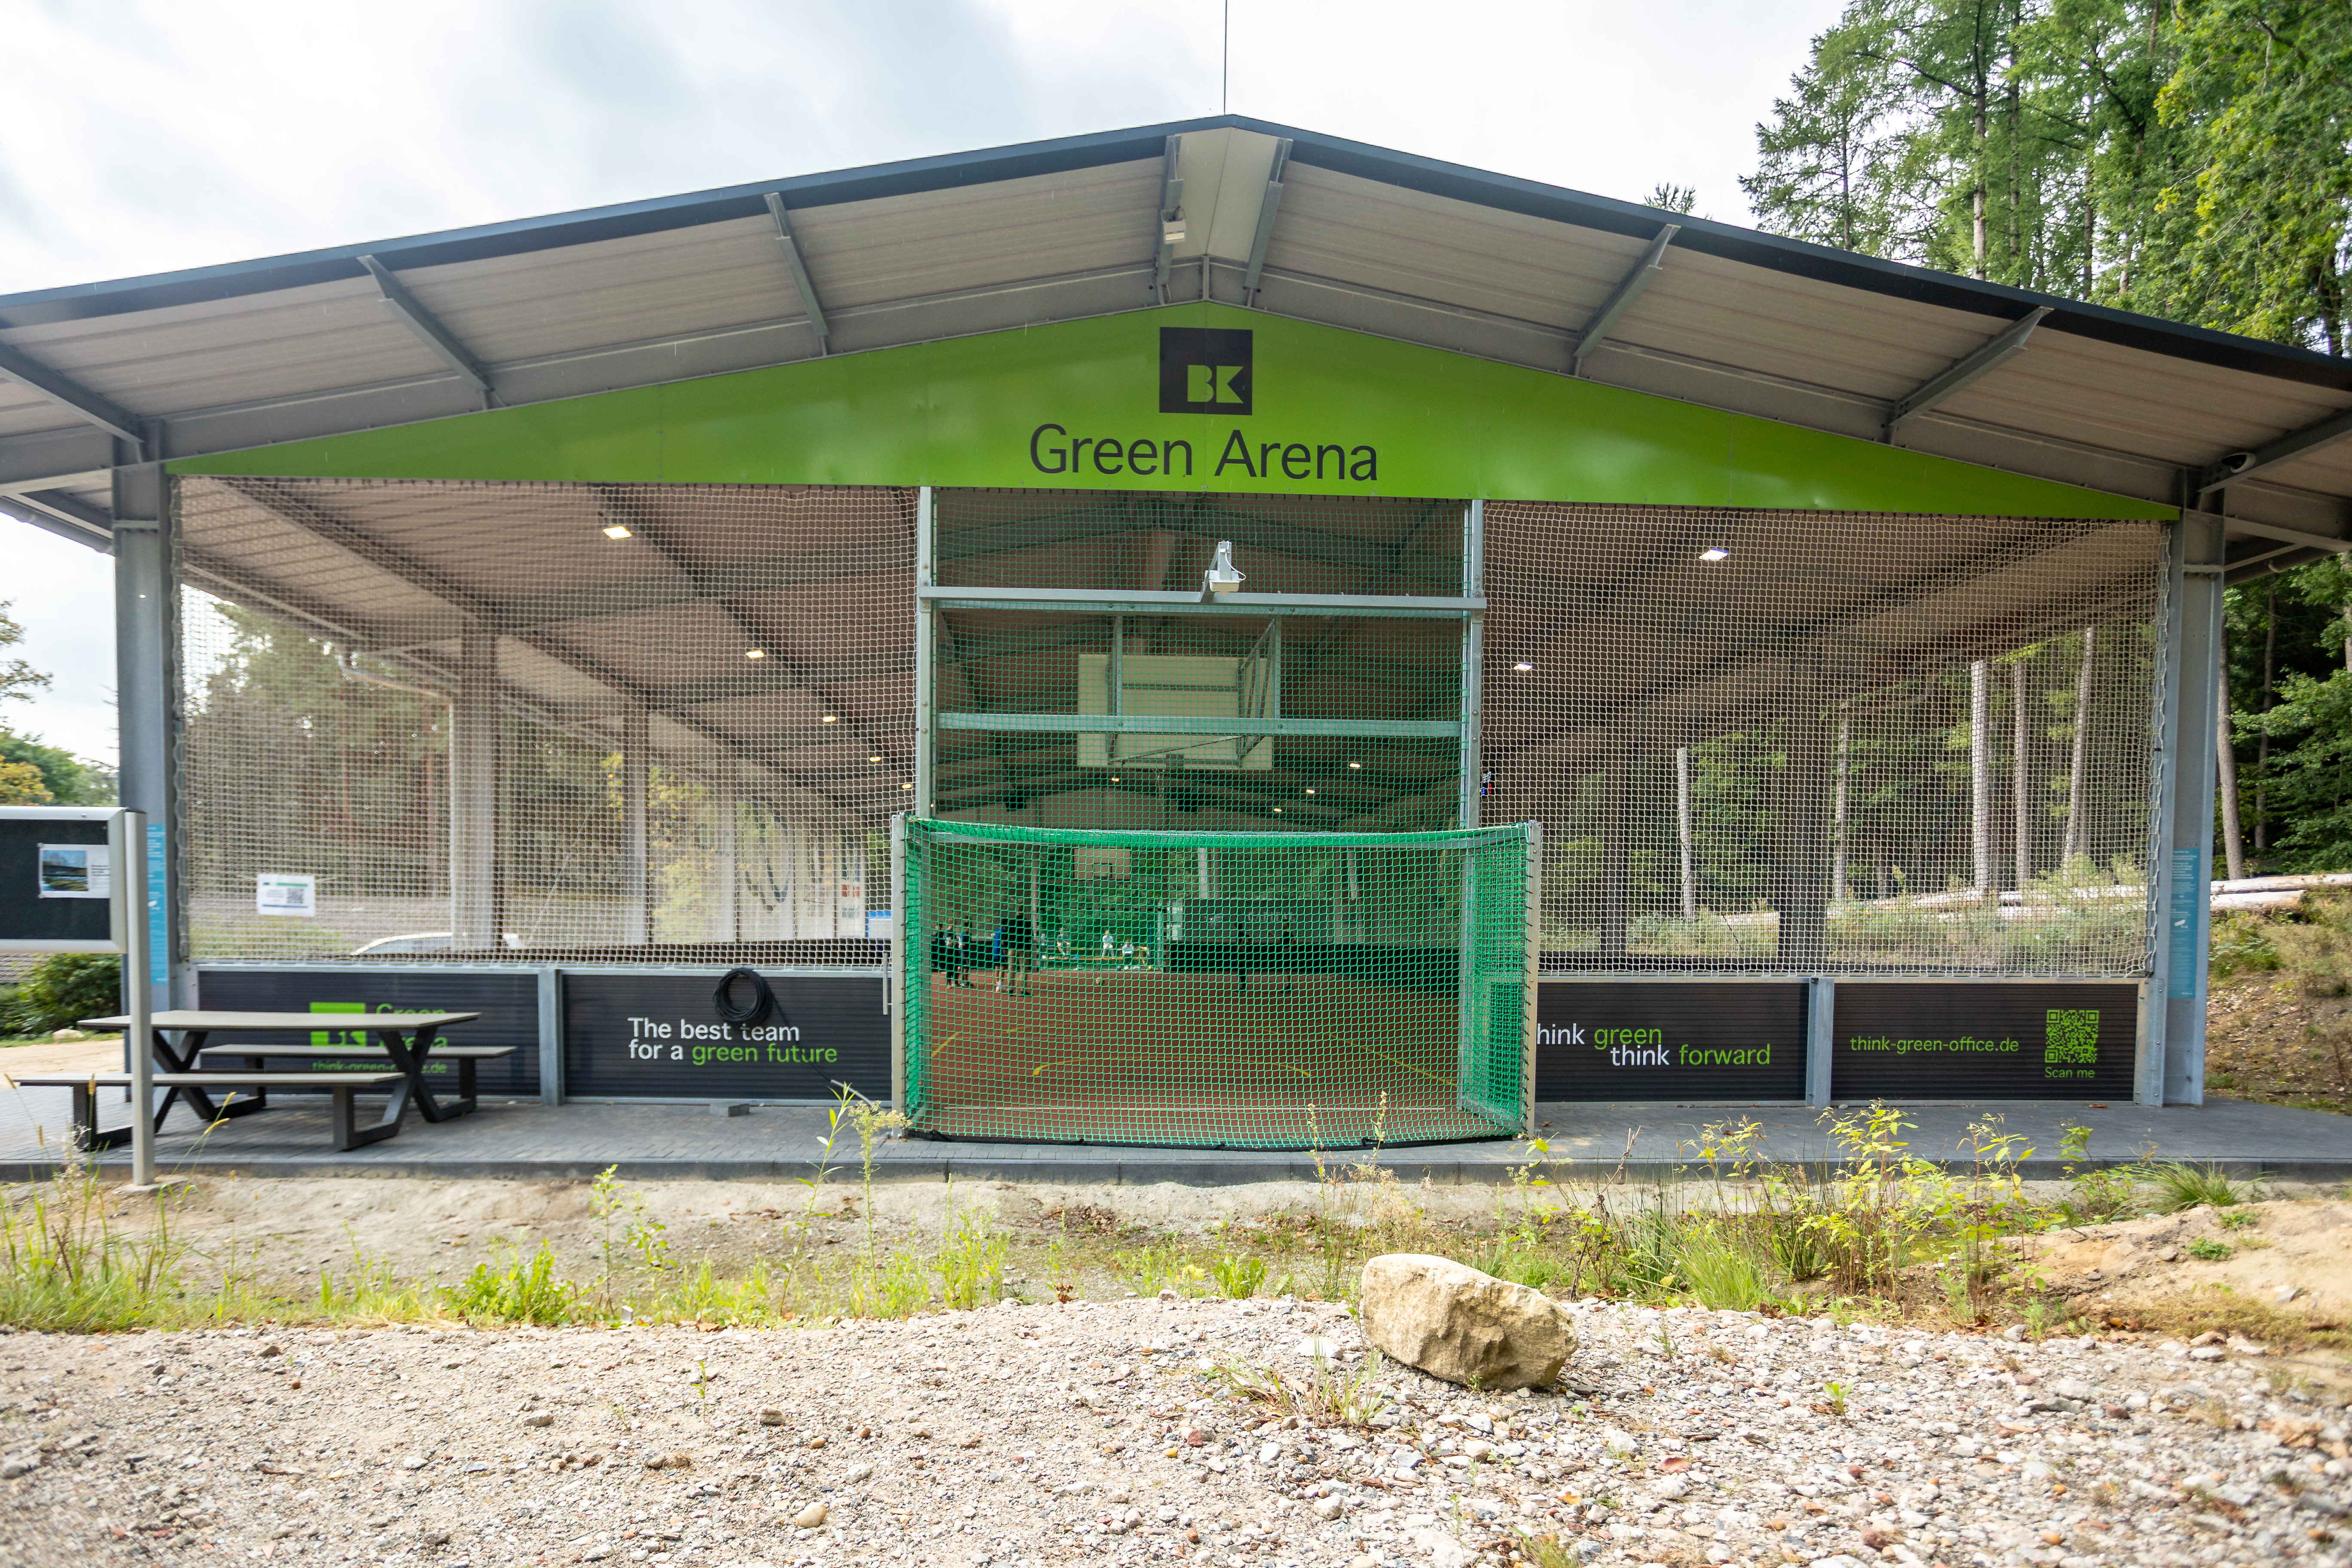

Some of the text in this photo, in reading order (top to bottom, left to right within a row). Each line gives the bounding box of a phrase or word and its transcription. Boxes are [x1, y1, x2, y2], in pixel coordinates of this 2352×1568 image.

[1187, 364, 1243, 403] BK
[1030, 423, 1378, 481] Green Arena
[627, 1017, 800, 1041] The best team
[1537, 1023, 1662, 1050] hink green
[628, 1038, 838, 1066] for a green future
[1610, 1044, 1770, 1066] think forward
[1850, 1035, 2019, 1055] think-green-office.de
[2045, 1066, 2095, 1078] Scan me
